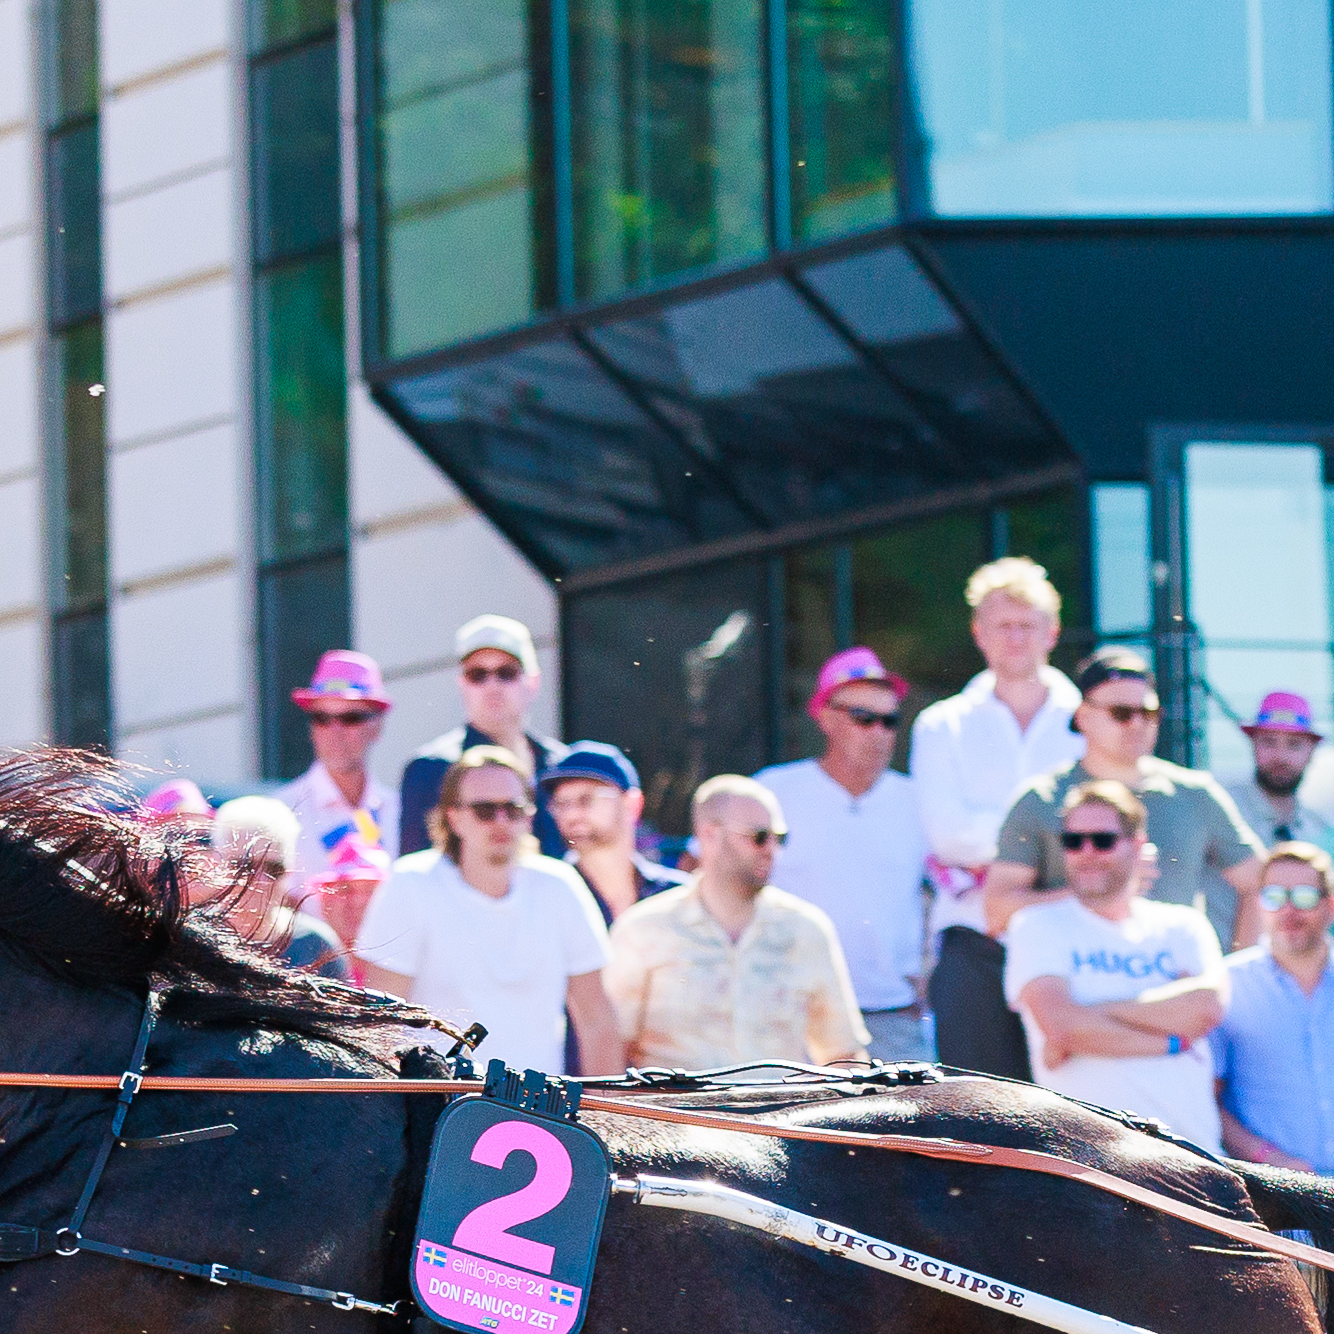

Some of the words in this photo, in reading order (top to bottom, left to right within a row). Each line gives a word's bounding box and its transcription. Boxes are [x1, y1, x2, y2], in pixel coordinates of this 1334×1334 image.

[451, 1120, 573, 1275] 2
[428, 1278, 461, 1302] DON
[463, 1289, 527, 1322] FANUCCI
[528, 1309, 558, 1331] ZET
